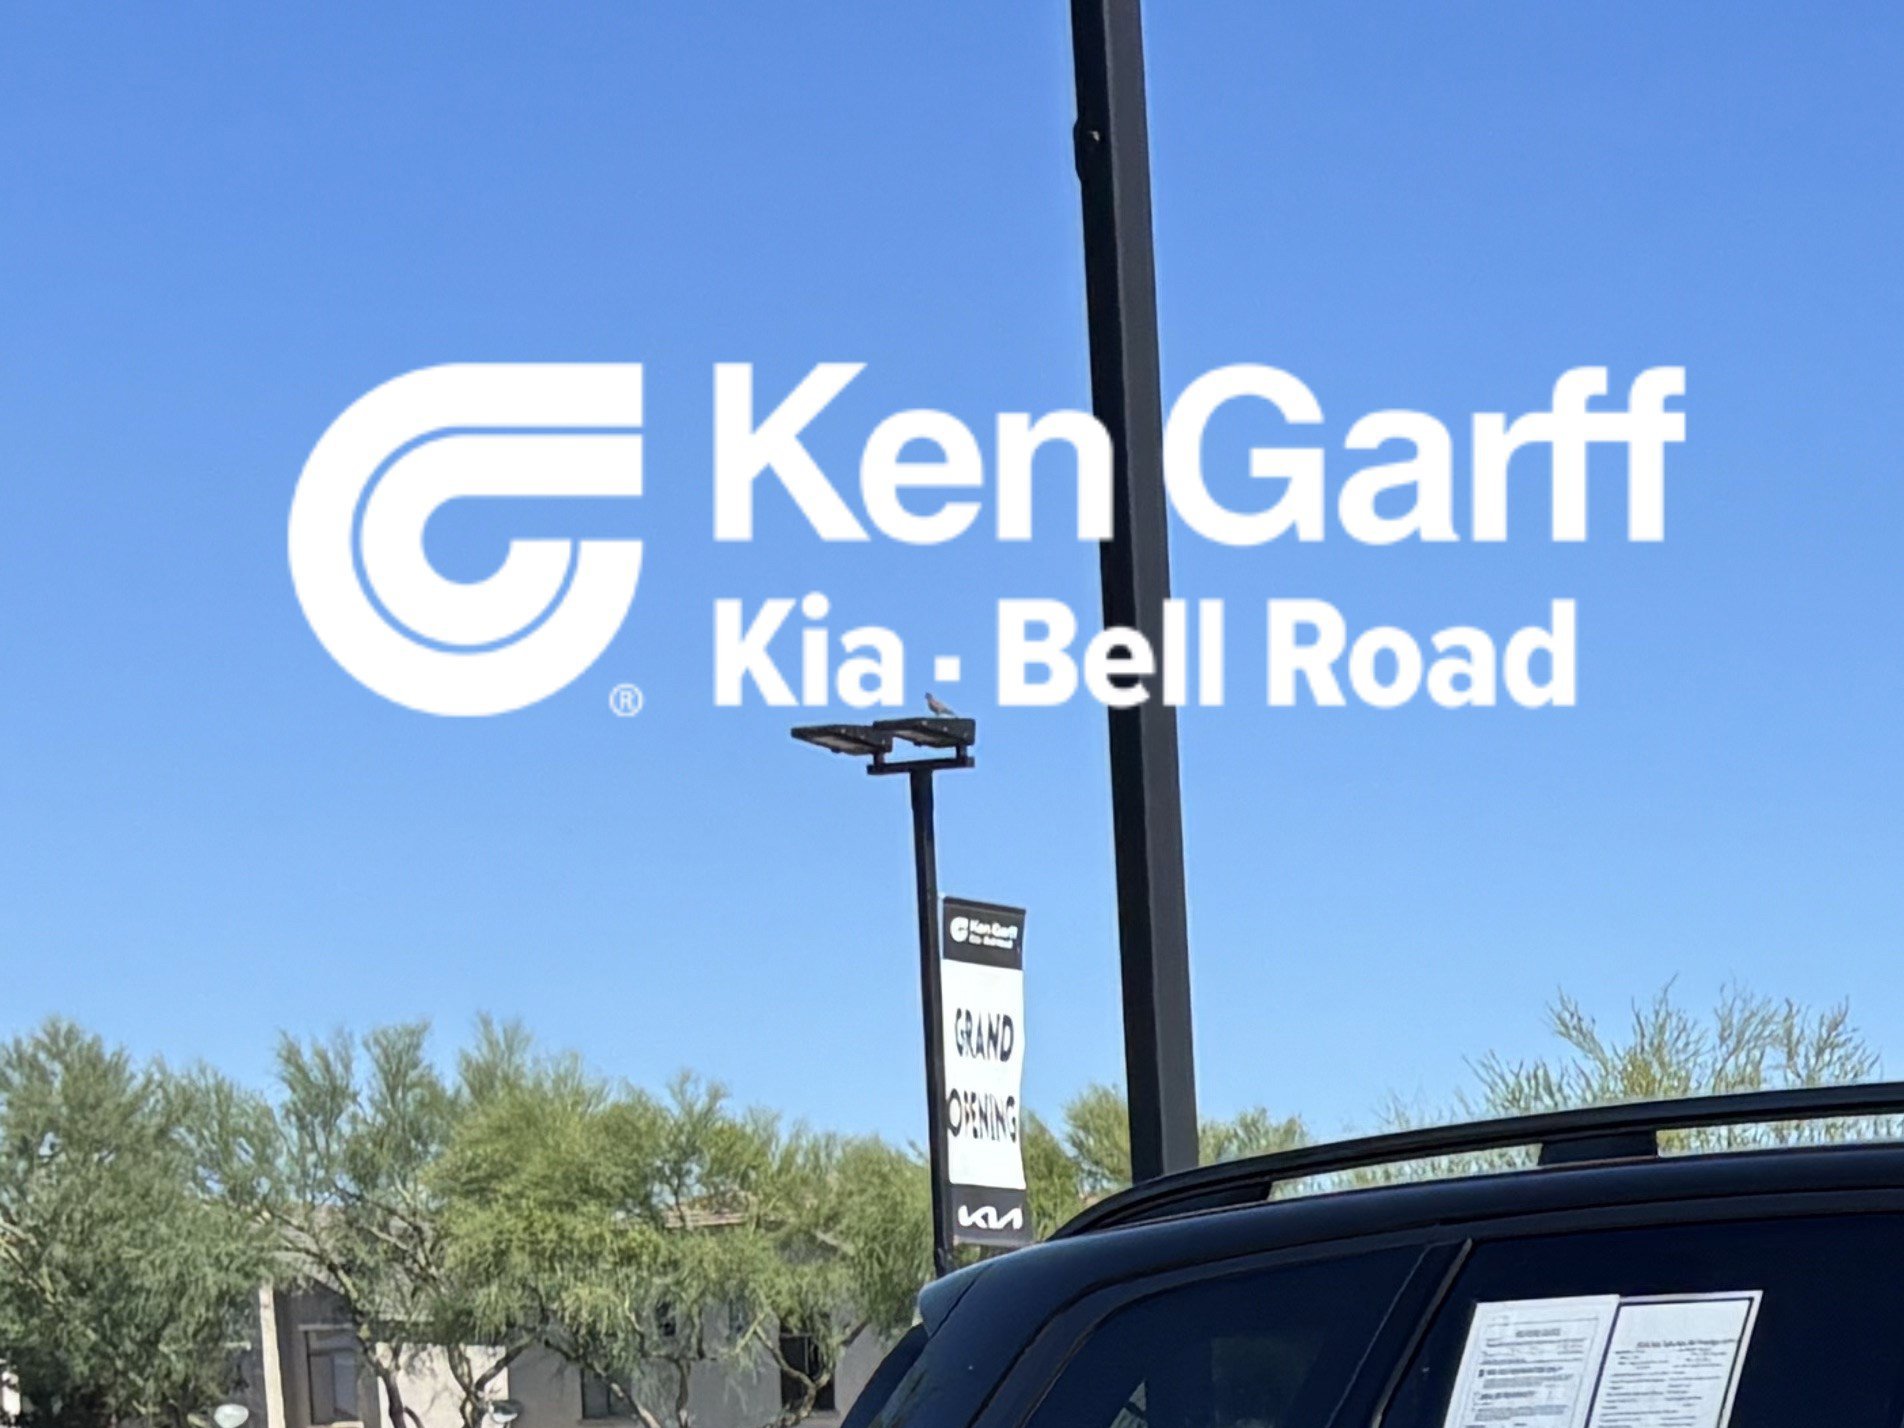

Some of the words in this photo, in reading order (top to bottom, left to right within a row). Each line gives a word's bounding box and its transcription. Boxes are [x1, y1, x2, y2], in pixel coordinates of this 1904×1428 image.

[954, 1007, 1014, 1062] GRAND
[948, 1088, 1017, 1143] OPENING
[957, 1205, 1024, 1230] KIA
